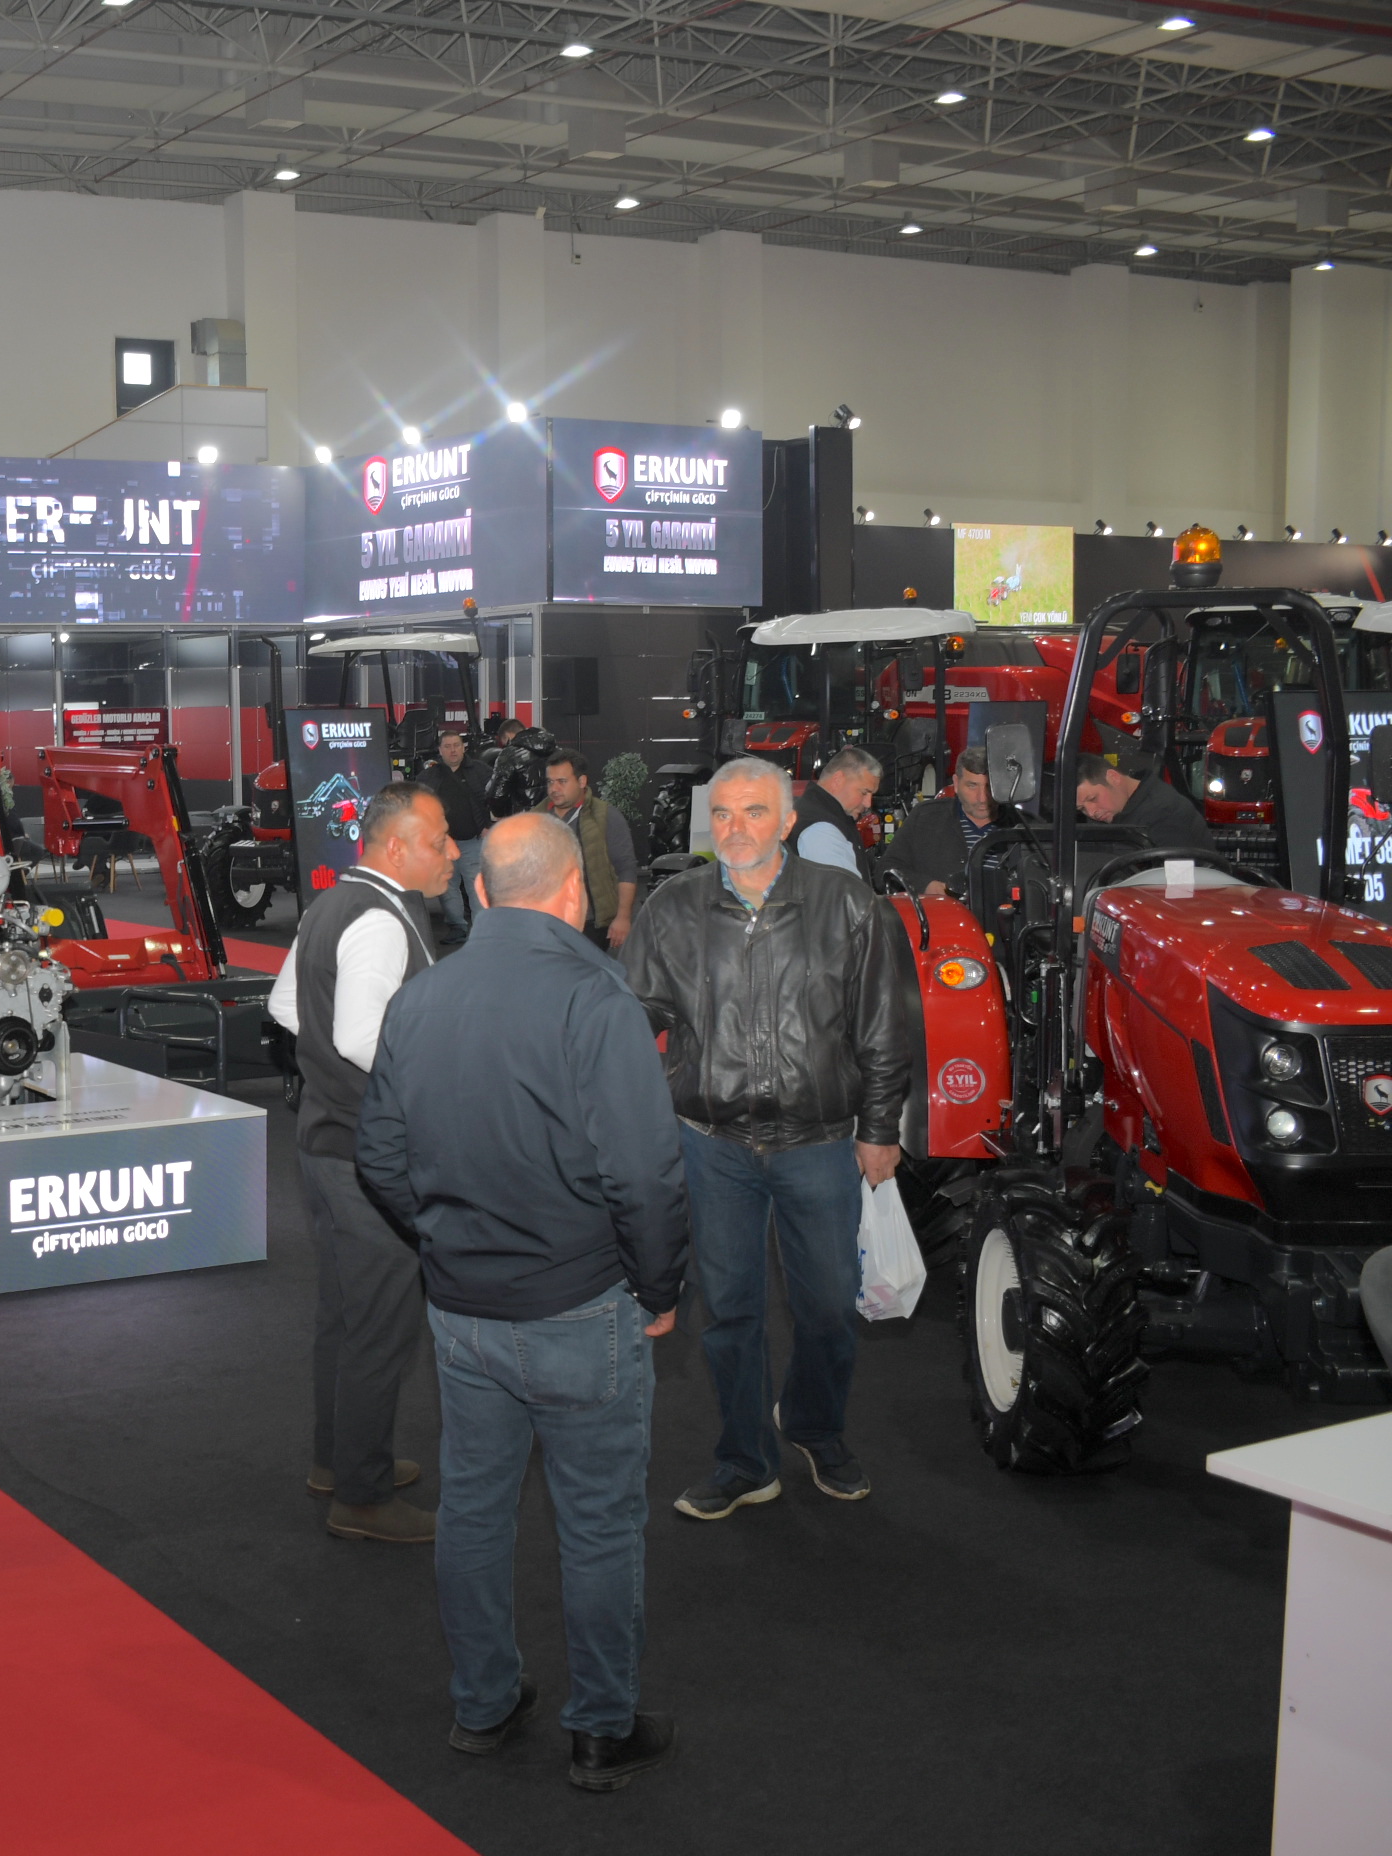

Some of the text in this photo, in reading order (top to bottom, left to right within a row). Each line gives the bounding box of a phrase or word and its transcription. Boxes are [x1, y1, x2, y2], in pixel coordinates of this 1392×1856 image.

[392, 443, 471, 487] ERKUNT
[633, 454, 728, 486] ERKUNT
[401, 485, 460, 510] ÇİFTÇİNİN GÜCÜ
[645, 489, 716, 505] ÇİFTÇİNİN GÜCÜ
[361, 508, 472, 569] 5 YIL GARANTİ
[605, 517, 716, 551] 5 YIL GARANTİ
[636, 553, 657, 573] YENİ
[659, 554, 684, 574] NESİL
[389, 571, 409, 598] YENİ
[411, 568, 437, 597] NESİL
[321, 722, 371, 738] ERKUNT
[946, 1074, 978, 1085] 3 YIL
[9, 1160, 193, 1224] ERKUNT
[32, 1219, 169, 1259] ÇİFTÇİNİN GÜCÜ
